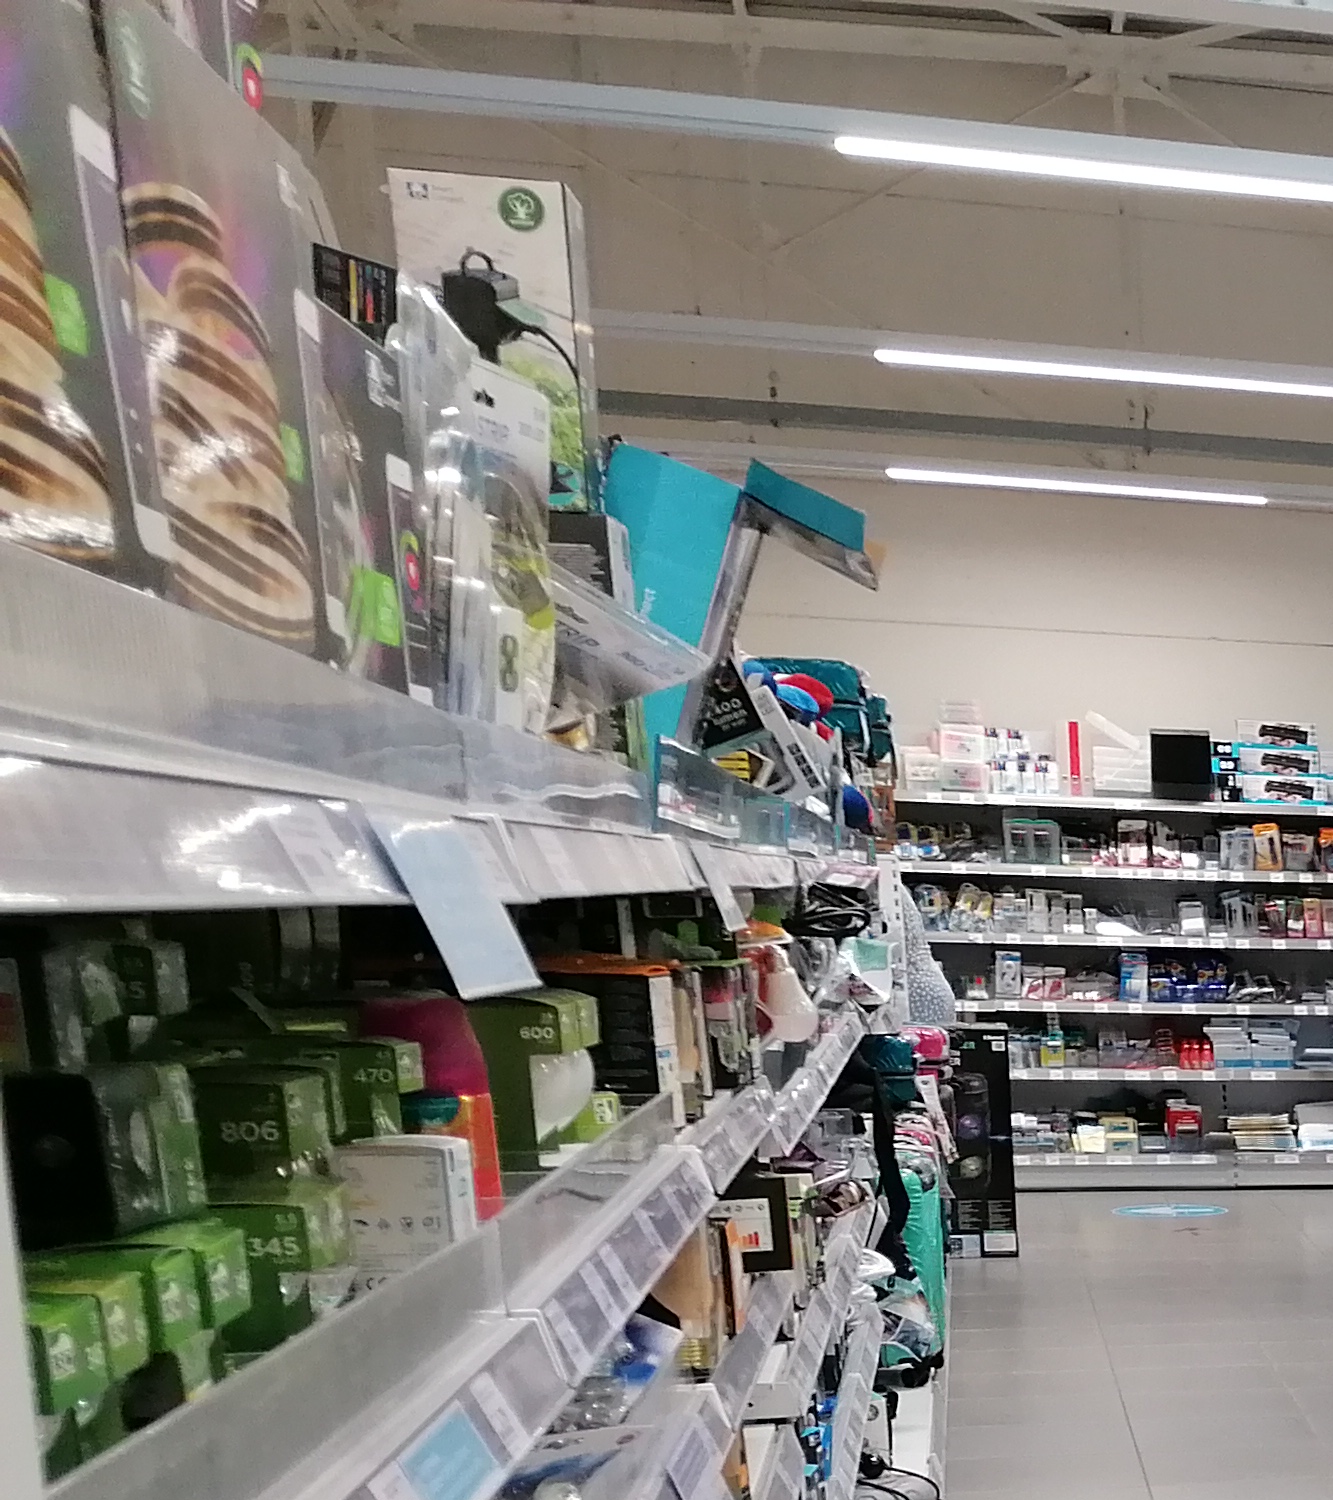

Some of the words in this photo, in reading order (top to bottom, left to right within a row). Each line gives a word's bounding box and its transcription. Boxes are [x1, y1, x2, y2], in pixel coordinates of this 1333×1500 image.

[519, 1025, 554, 1041] 600
[353, 1066, 392, 1084] 470
[220, 1120, 281, 1142] 806
[249, 1236, 299, 1258] 345
